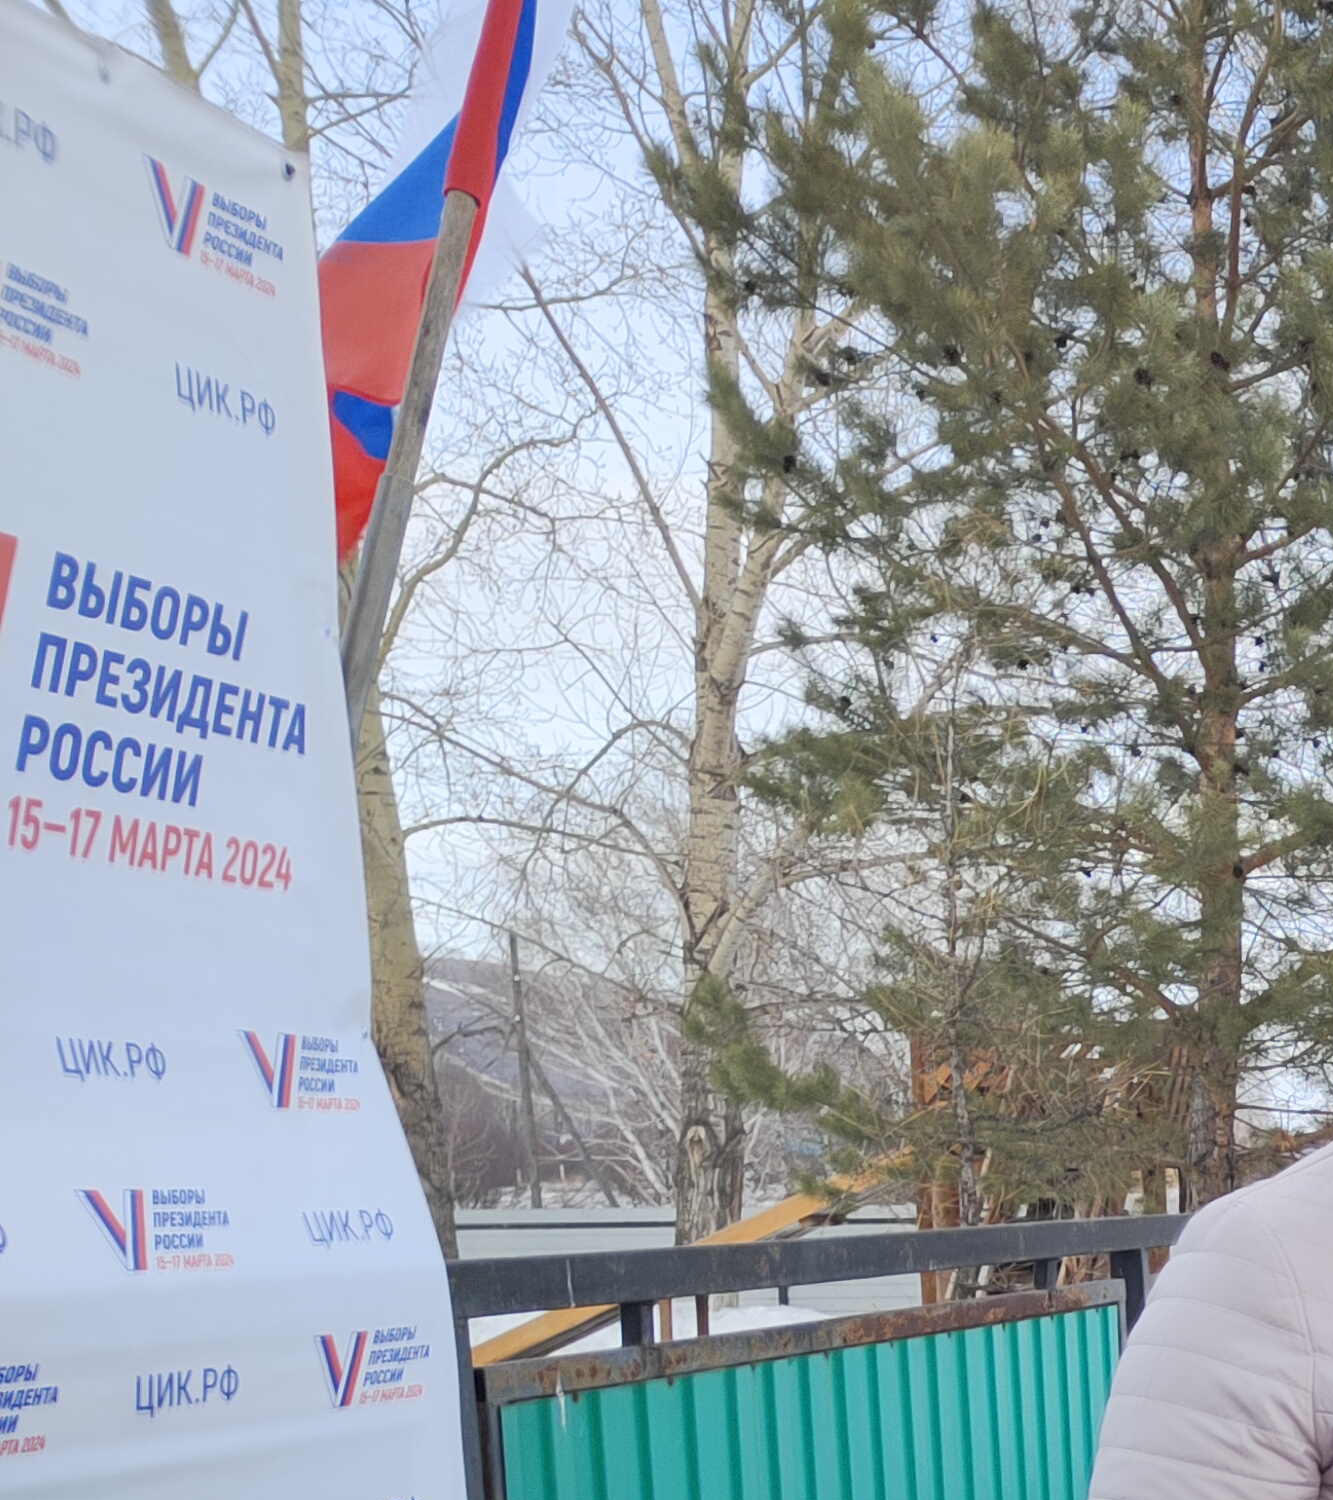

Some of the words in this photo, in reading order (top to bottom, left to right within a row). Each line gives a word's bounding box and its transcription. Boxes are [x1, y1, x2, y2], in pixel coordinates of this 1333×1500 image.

[212, 191, 267, 231] ВЫБОРЫ
[203, 231, 253, 267] РОССИИ
[206, 211, 284, 261] ПРЕЗИДЕНТА
[175, 361, 276, 437] ЦИК.РФ
[46, 551, 249, 662] ВЫБОРЫ
[31, 631, 306, 755] ПРЕЗИДЕНТА
[15, 714, 204, 807] РОССИИ
[108, 814, 214, 880] МАРТА
[56, 1036, 166, 1082] ЦИК.РФ
[152, 1189, 206, 1205] ВЫБОРЫ
[153, 1211, 229, 1228] ПРЕЗИДЕНТА
[154, 1233, 203, 1250] РОССИИ
[302, 1208, 394, 1250] ЦИК.РФ
[0, 1363, 40, 1384] БОРЫ
[136, 1364, 239, 1418] ЦИК.РФ
[0, 1386, 58, 1411] ИДЕНТА
